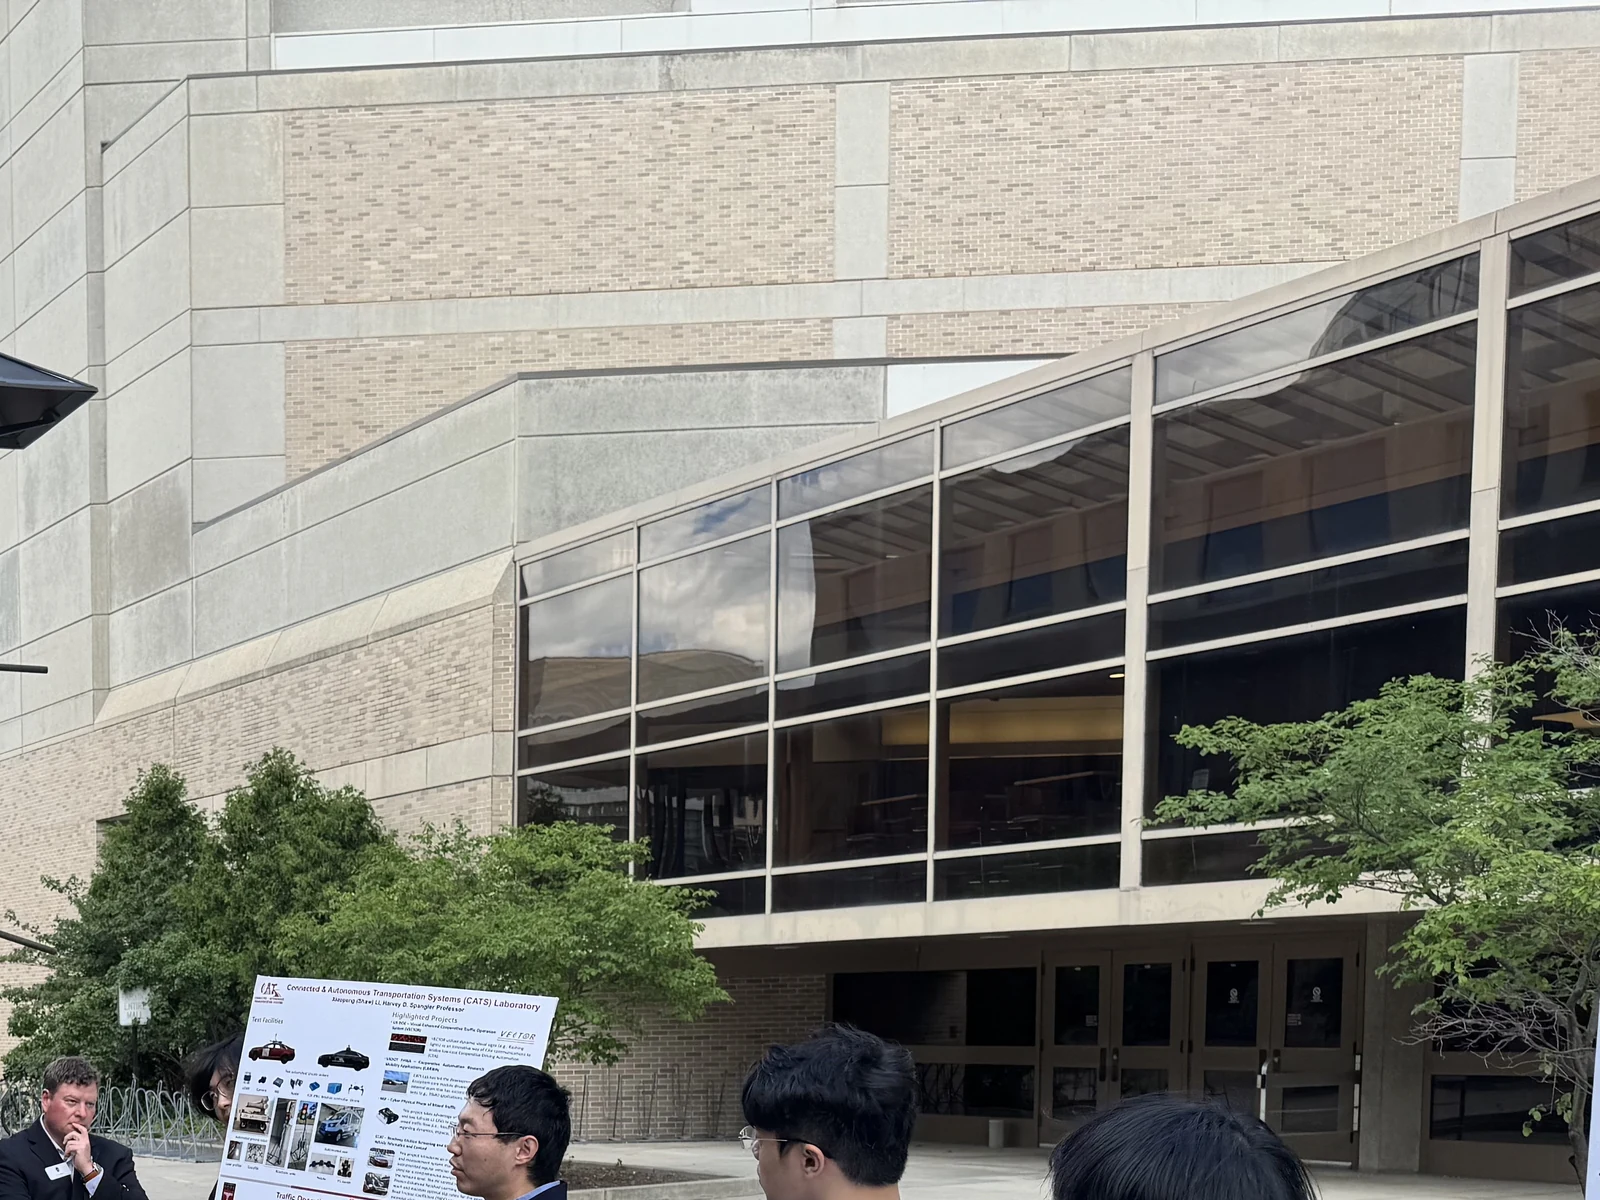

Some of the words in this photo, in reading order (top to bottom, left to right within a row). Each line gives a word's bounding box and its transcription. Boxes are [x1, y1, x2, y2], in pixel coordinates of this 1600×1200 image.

[286, 984, 320, 992] Connected
[327, 986, 370, 995] Autonomous
[373, 989, 425, 999] Transportation
[427, 994, 460, 1003] Systems
[463, 996, 491, 1007] (CATS)
[494, 999, 540, 1012] Laboratory
[409, 1002, 434, 1010] Spangler
[392, 1011, 429, 1021] Highlighted
[431, 1015, 457, 1023] Projects
[500, 1030, 536, 1039] VECTOR
[276, 1191, 295, 1200] Traffic
